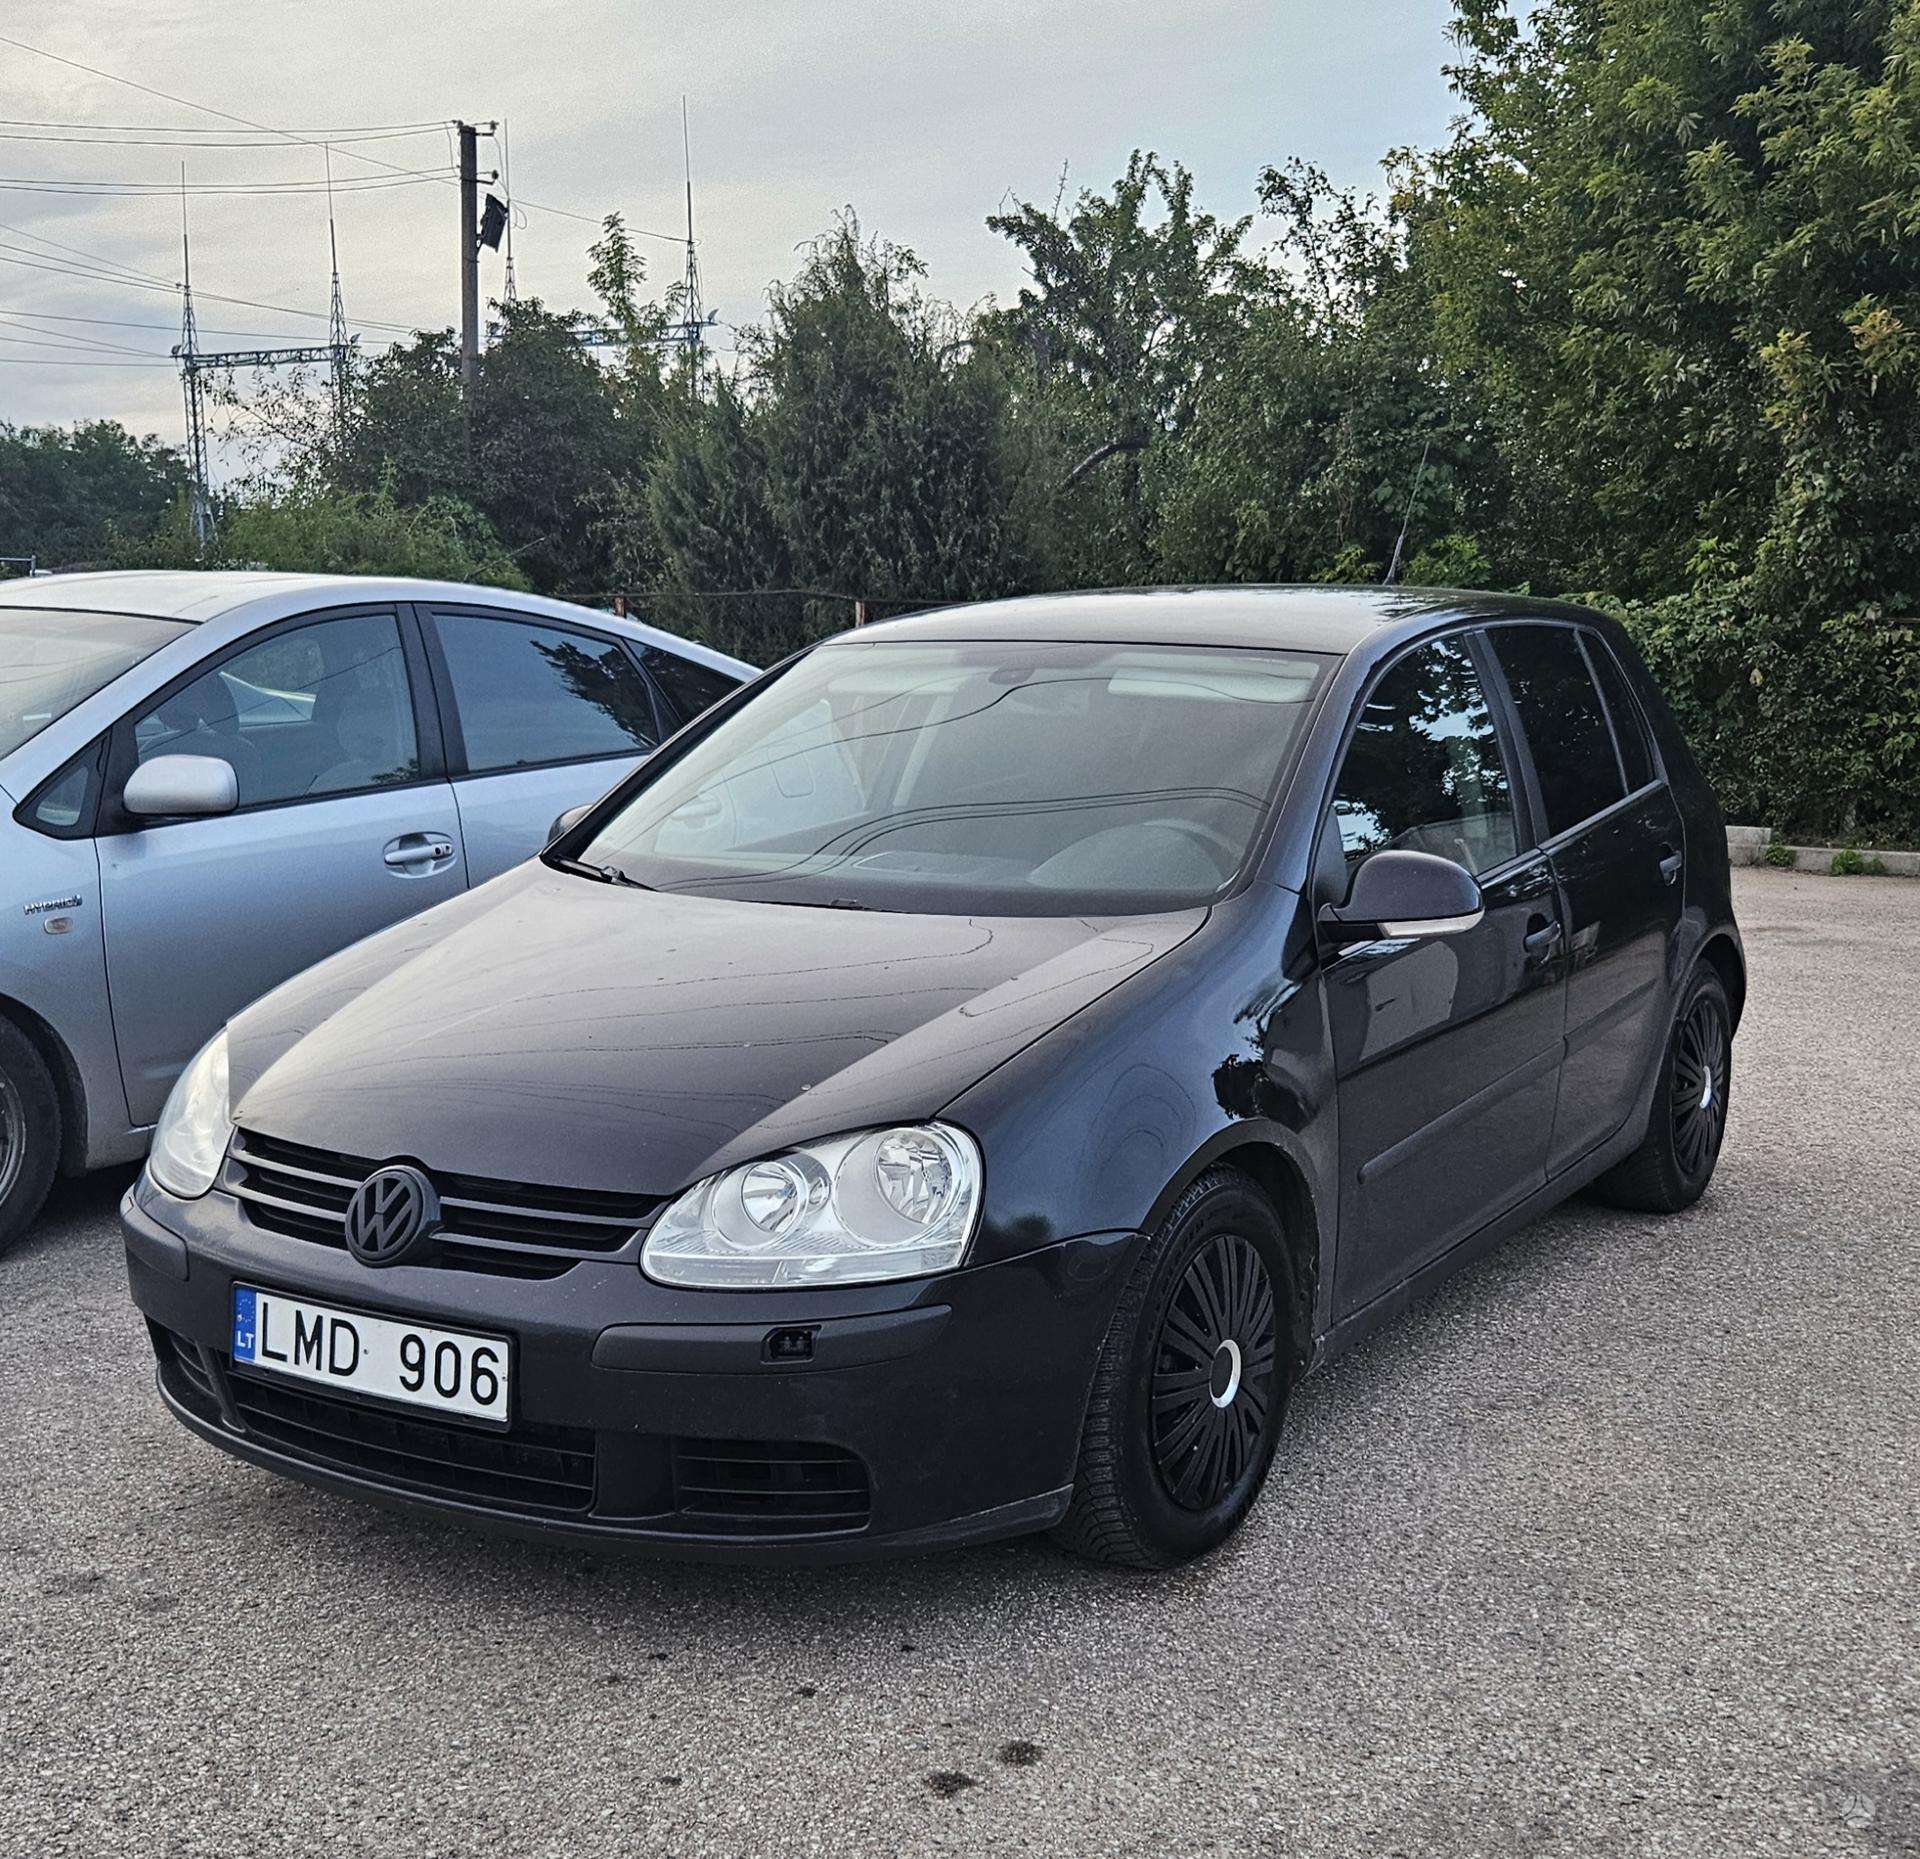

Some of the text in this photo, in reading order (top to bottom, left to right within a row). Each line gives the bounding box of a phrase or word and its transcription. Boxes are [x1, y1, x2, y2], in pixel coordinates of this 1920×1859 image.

[236, 1330, 255, 1349] LT
[262, 1302, 499, 1406] LMD 906
